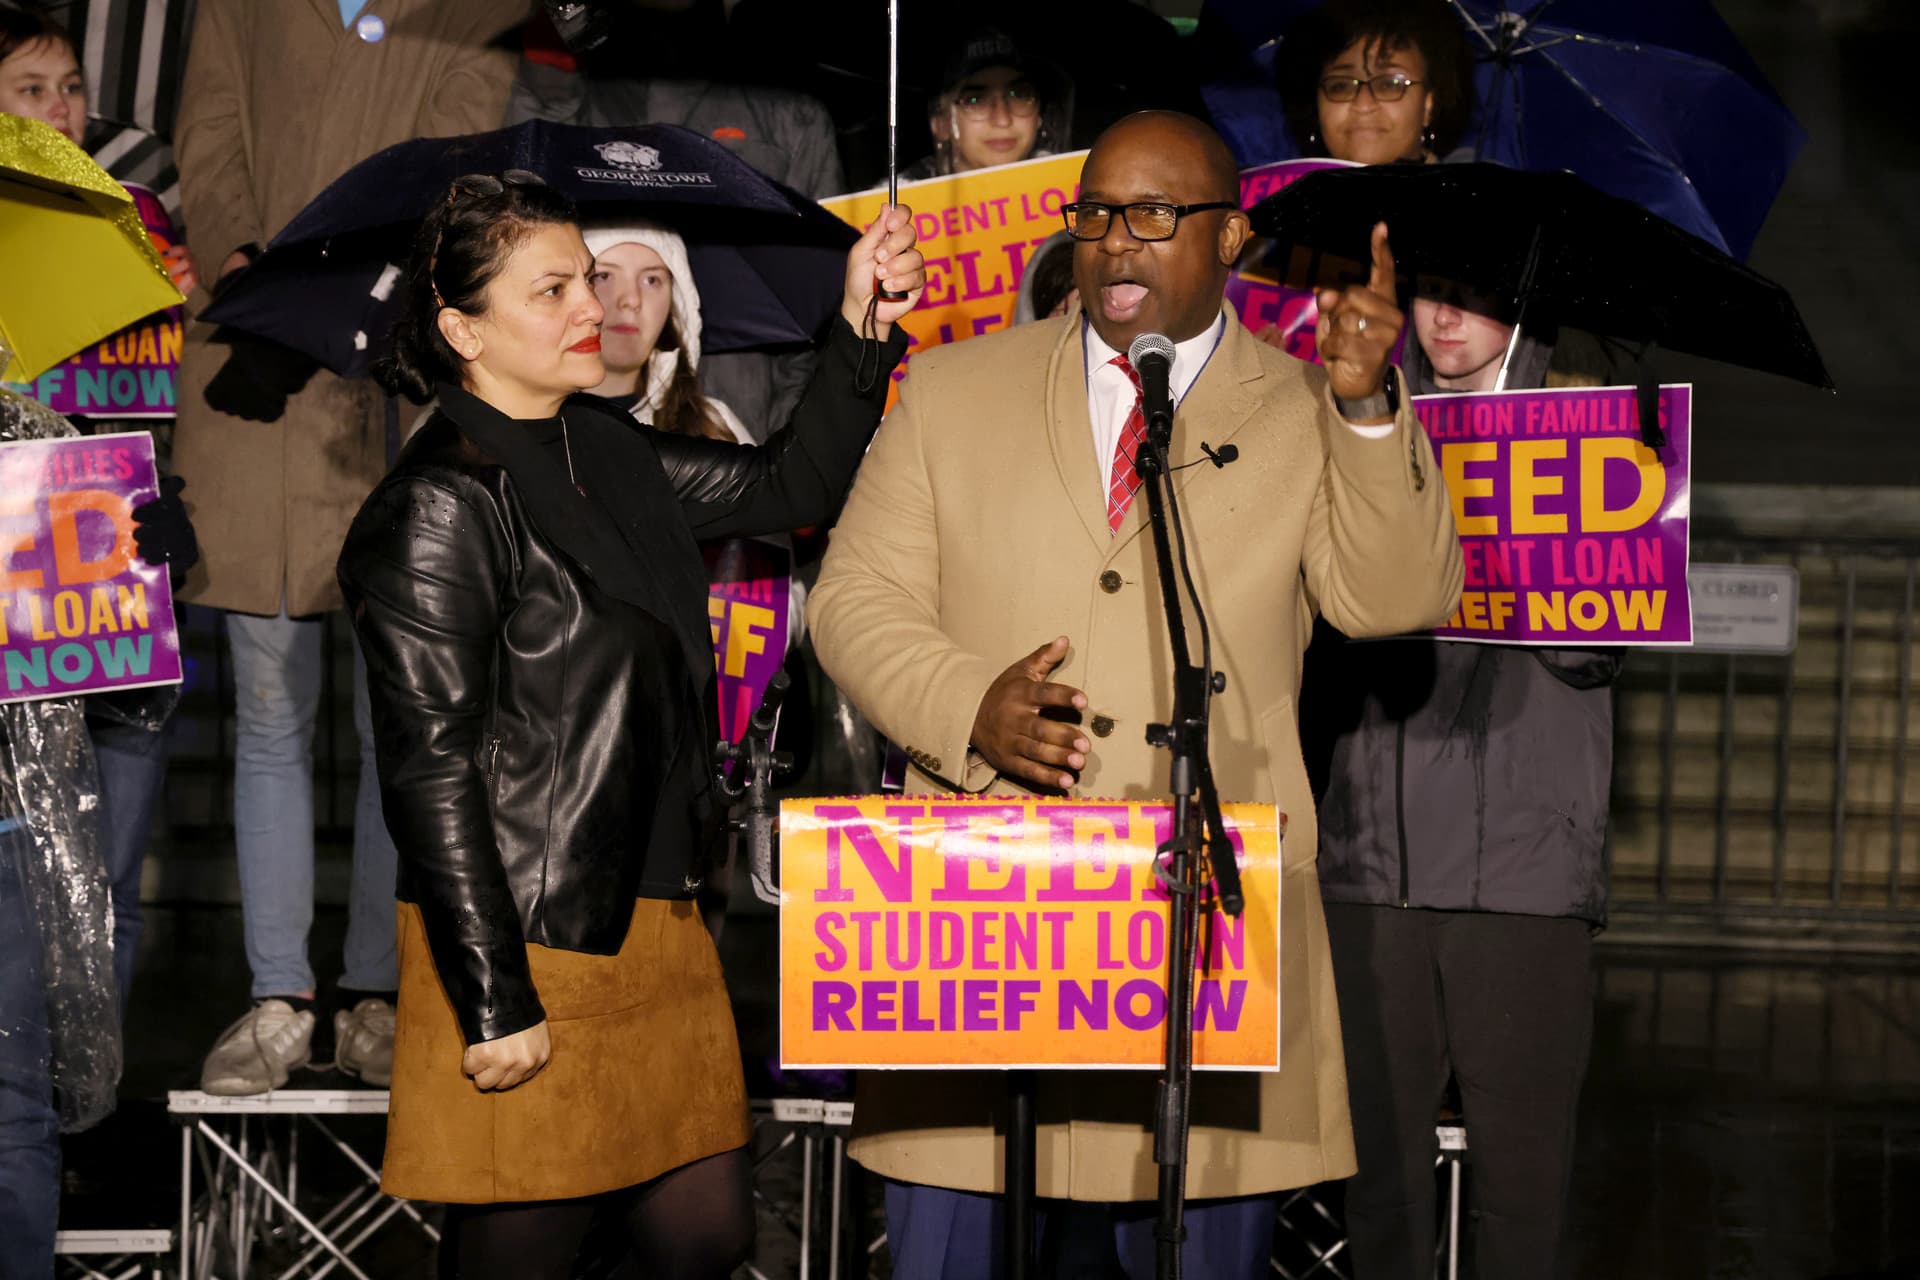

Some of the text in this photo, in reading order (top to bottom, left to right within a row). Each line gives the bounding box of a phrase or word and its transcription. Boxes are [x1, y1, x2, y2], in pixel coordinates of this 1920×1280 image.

[577, 169, 712, 184] GEORGETOWN
[75, 368, 178, 408] NOW
[1414, 401, 1515, 439] ILLION
[41, 447, 134, 488] ILIES
[1441, 436, 1667, 536] EED
[1462, 537, 1664, 587] ENT LOAN
[31, 583, 149, 641] LOAN
[1526, 589, 1668, 632] NOW
[5, 634, 154, 691] NOW
[814, 910, 1245, 972] STUDENT LON
[812, 978, 1249, 1033] RELIEF NOW
